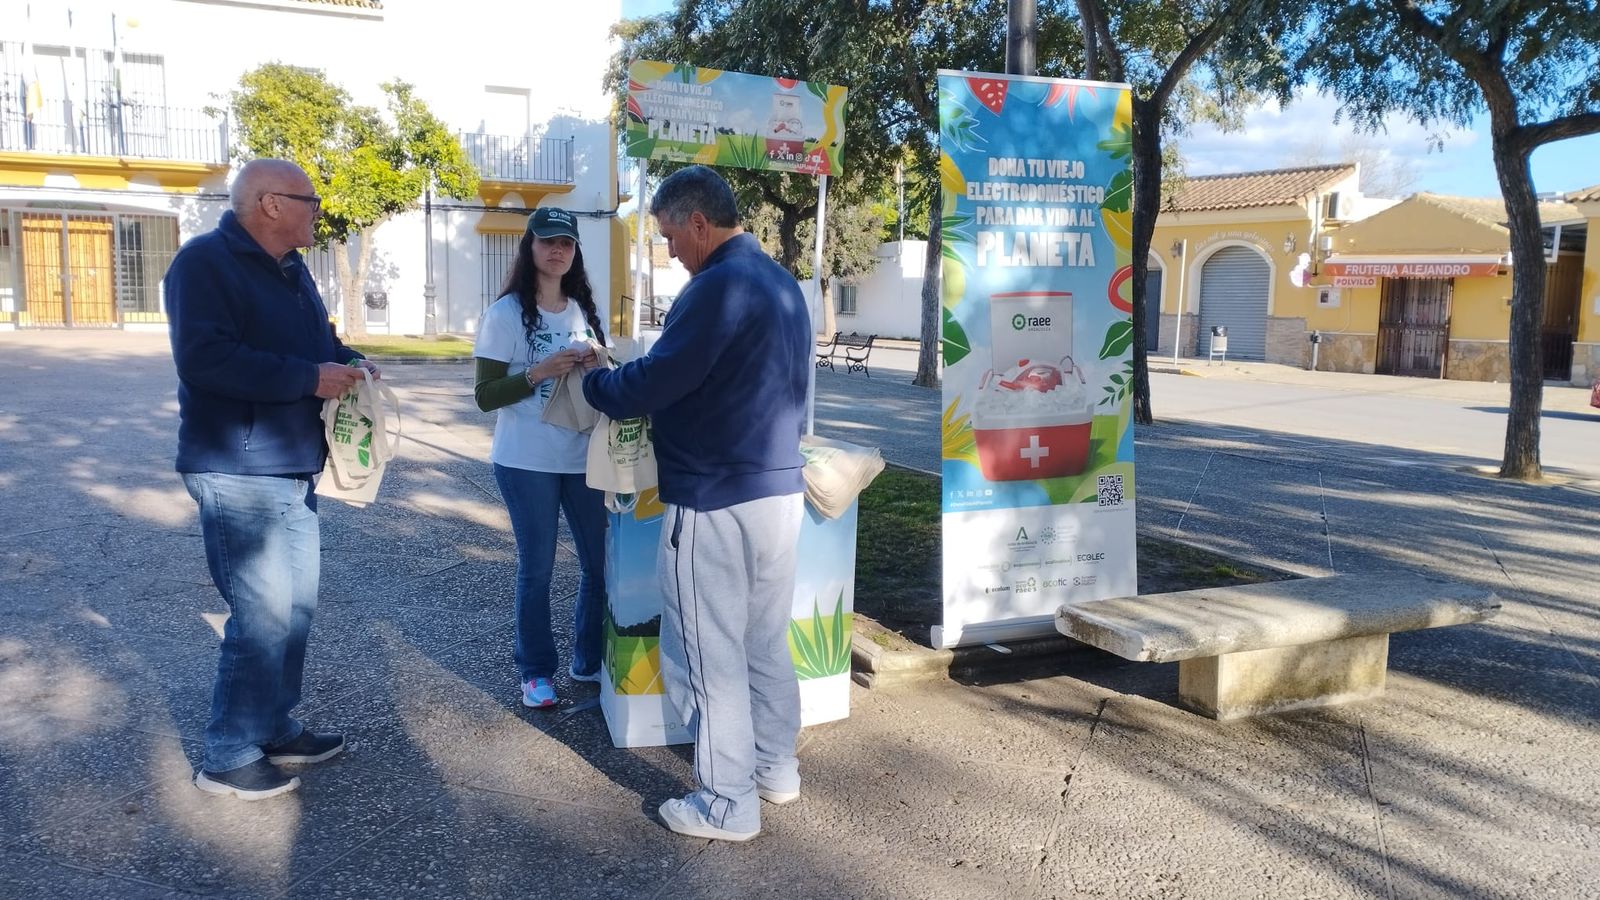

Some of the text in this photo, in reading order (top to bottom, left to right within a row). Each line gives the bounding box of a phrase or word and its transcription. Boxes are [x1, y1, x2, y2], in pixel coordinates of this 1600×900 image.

[656, 80, 712, 96] DONA TU VIEJO
[649, 106, 717, 123] PARA DAR VIDA AL
[648, 119, 716, 144] PLANETA
[988, 157, 1085, 180] DONA TU VIEJO
[966, 181, 1105, 204] ELECTRODOMÉSTICO
[976, 206, 1096, 227] PARA DAR VIDA AL
[976, 232, 1096, 267] PLANETA
[1344, 264, 1471, 276] FRUTERIA ALEJANDRO
[1336, 278, 1375, 286] POLVILLO
[1028, 317, 1051, 326] raee
[1077, 553, 1105, 562] ECOLEC
